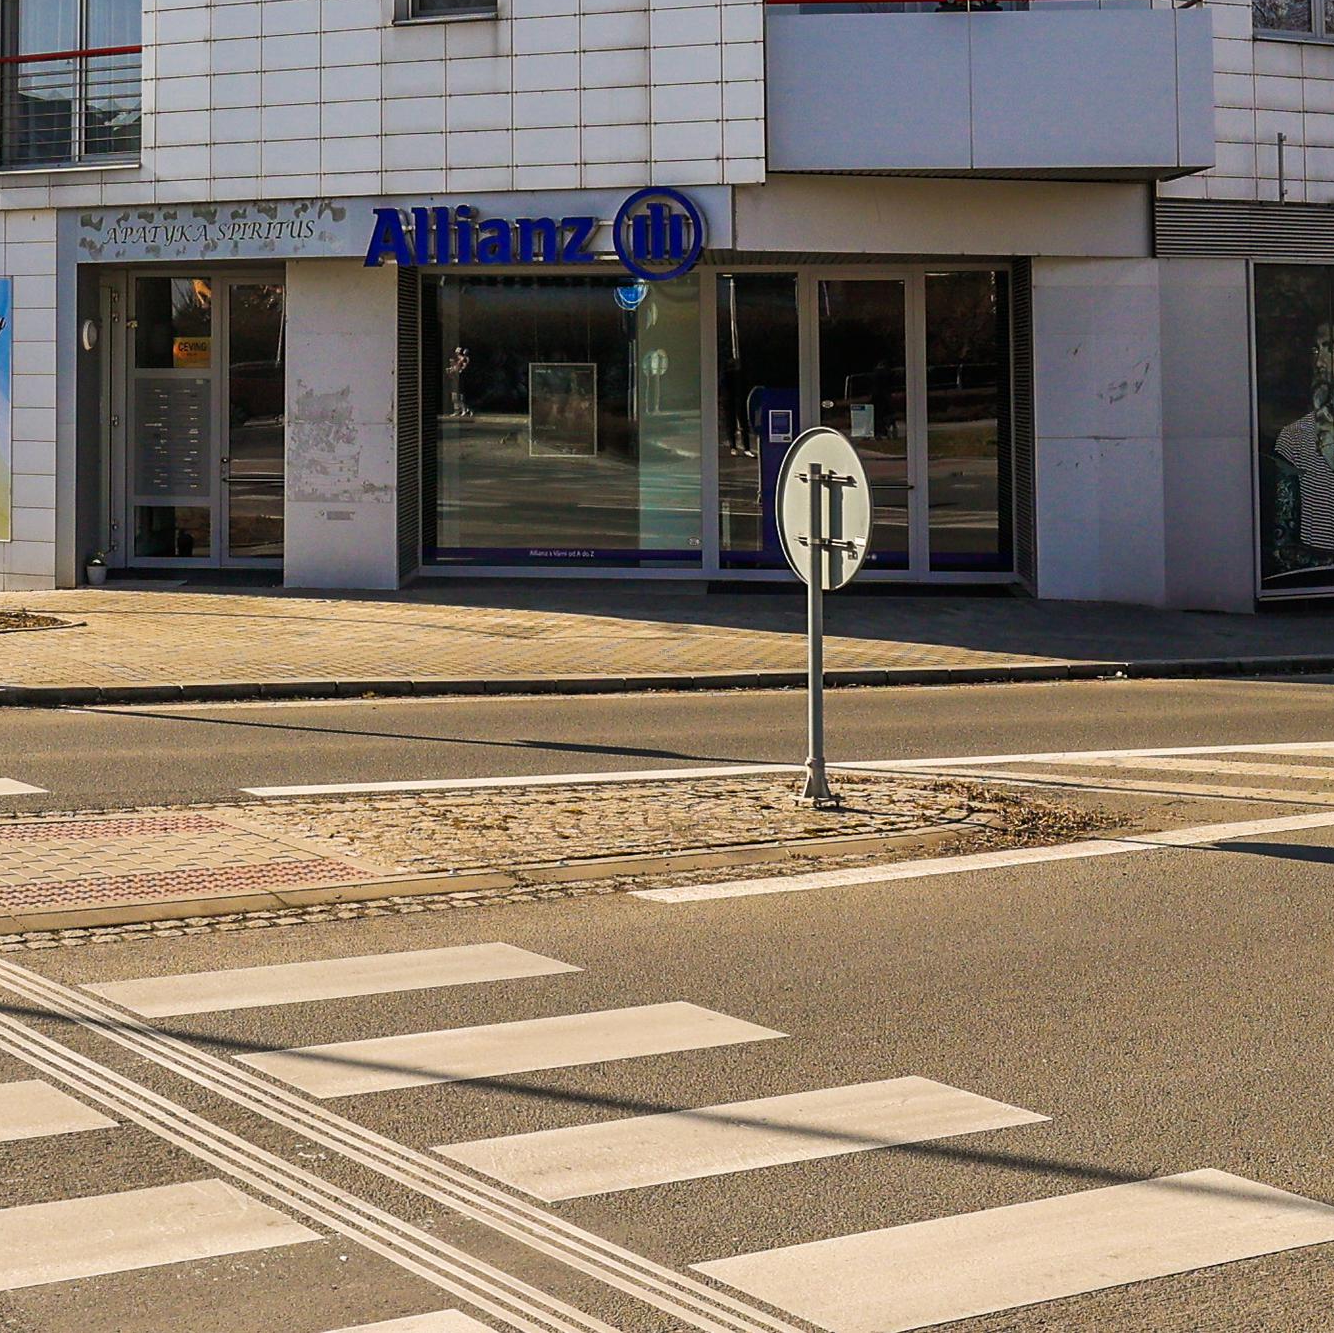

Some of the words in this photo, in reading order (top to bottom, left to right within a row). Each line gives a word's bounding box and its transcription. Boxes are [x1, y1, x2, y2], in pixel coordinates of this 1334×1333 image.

[102, 224, 209, 247] APATYKA
[216, 219, 315, 241] SPIRITUS
[364, 204, 596, 267] Allianz
